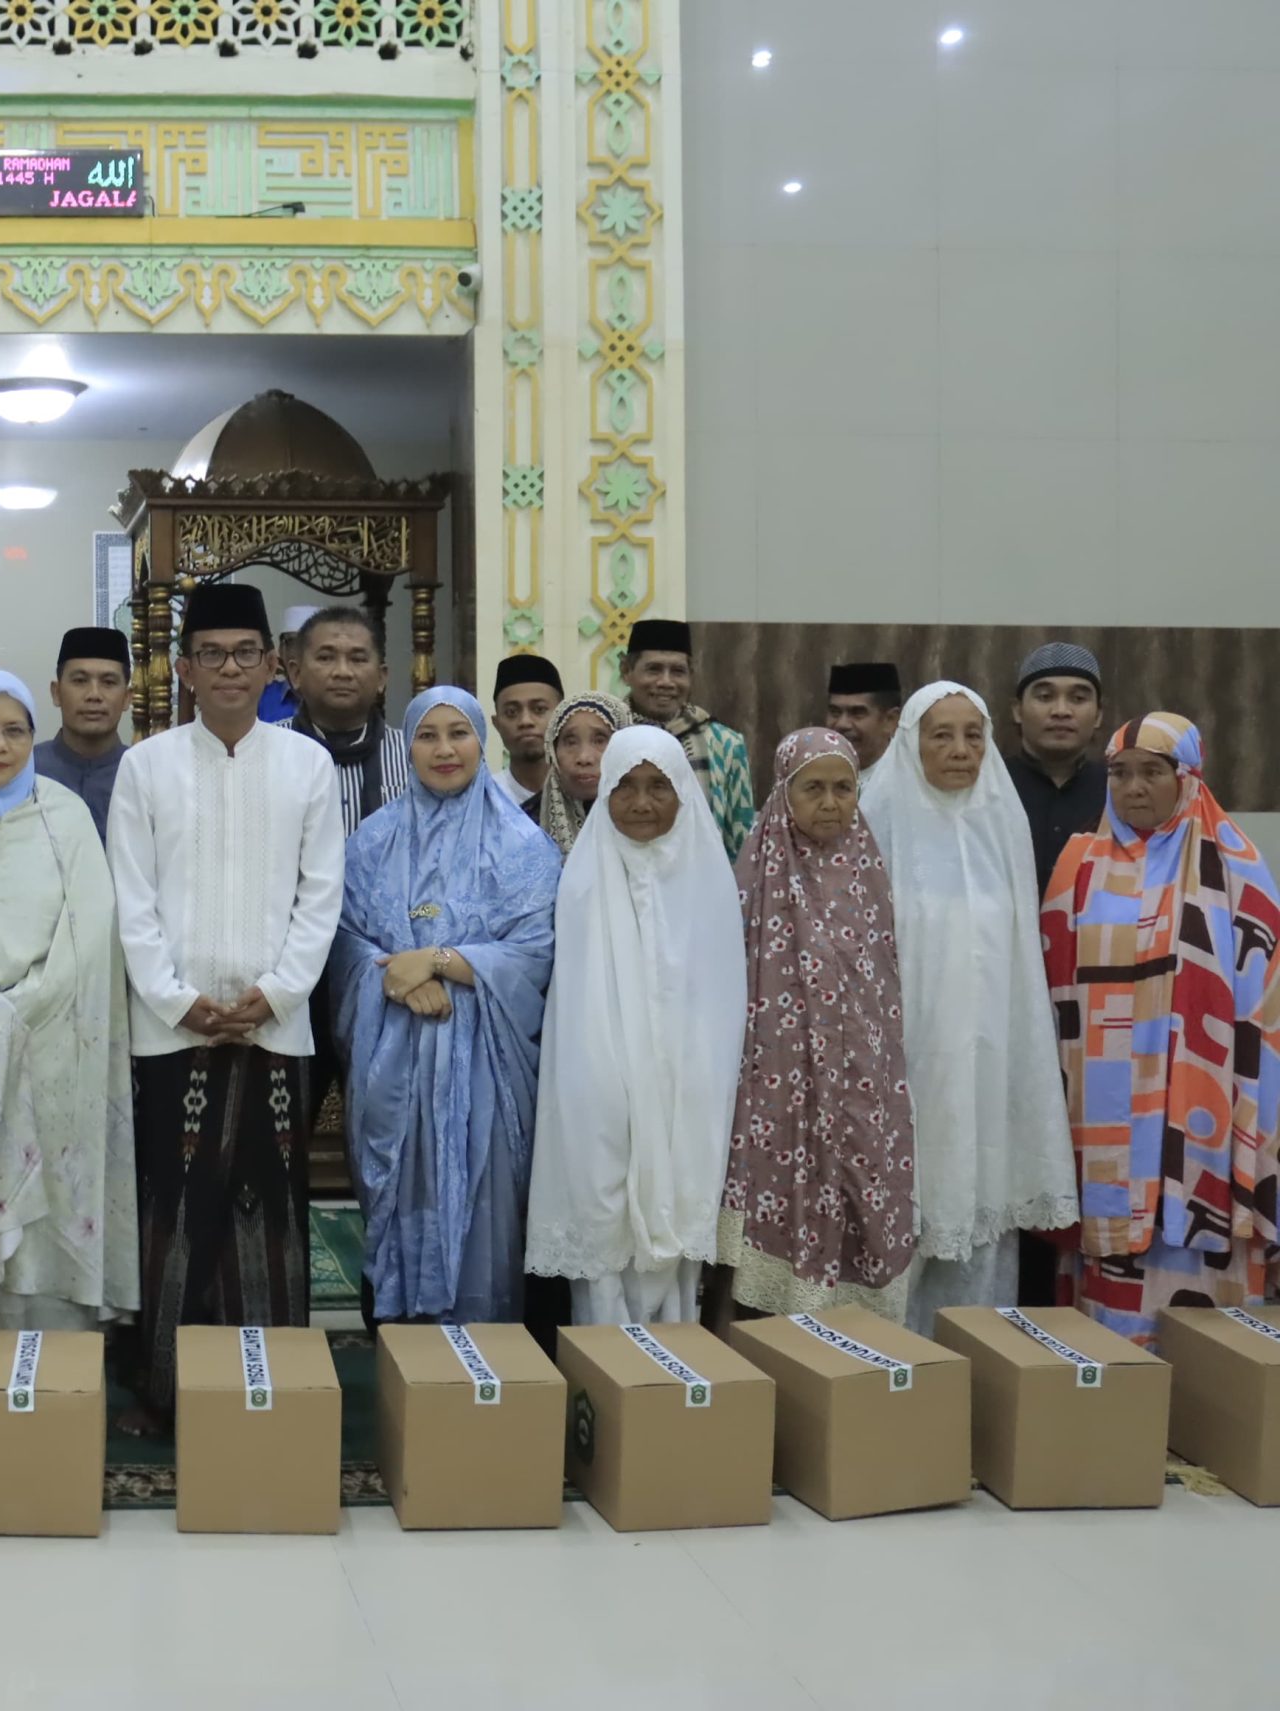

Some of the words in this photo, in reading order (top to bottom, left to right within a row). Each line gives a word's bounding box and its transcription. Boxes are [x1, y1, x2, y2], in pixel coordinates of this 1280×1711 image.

[3, 157, 71, 171] RAMADHAN
[43, 171, 54, 185] H
[87, 156, 134, 189] الله
[797, 1314, 842, 1342] SOSIAL
[1003, 1309, 1045, 1337] SOSIAL
[1227, 1309, 1276, 1333] SOSIAL
[20, 1332, 40, 1359] SOSIAL
[242, 1329, 263, 1362] BANTUAN
[446, 1323, 473, 1349] SOSIAL
[461, 1348, 496, 1380] BANTUAN
[624, 1326, 674, 1362] BANTUAN
[662, 1360, 703, 1384] SOSIAL
[837, 1340, 902, 1368] BANTUAN
[246, 1363, 267, 1386] SOSIAL
